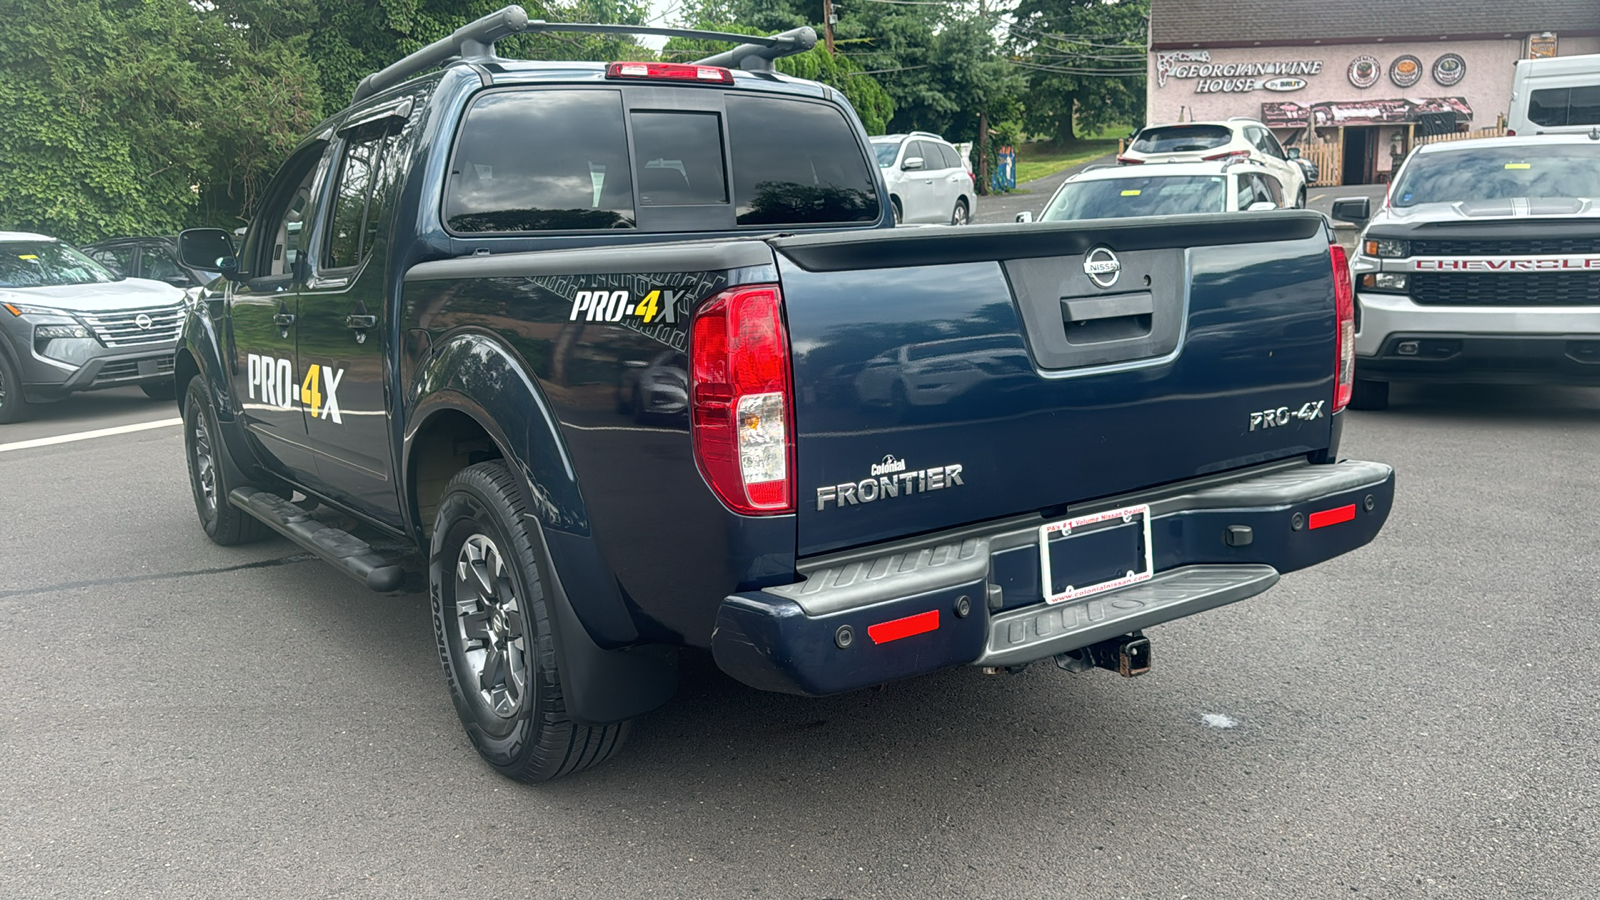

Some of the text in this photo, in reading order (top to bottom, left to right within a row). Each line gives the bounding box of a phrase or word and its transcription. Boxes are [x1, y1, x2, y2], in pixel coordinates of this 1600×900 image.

[1175, 61, 1323, 78] GEORGIAN WINE
[1195, 79, 1256, 93] HOUSE
[1089, 262, 1120, 272] NISSAN
[569, 289, 685, 324] PRO-4X
[247, 353, 345, 424] PRO-4X
[1249, 400, 1325, 432] PRO-4X
[871, 459, 906, 476] Colonial
[816, 463, 964, 511] FRONTIER
[1063, 521, 1073, 530] #1
[1075, 516, 1099, 526] Volume
[1101, 511, 1122, 521] Nissan
[1124, 506, 1147, 516] Dealer!
[1051, 573, 1150, 603] www.colonialnissan.com
